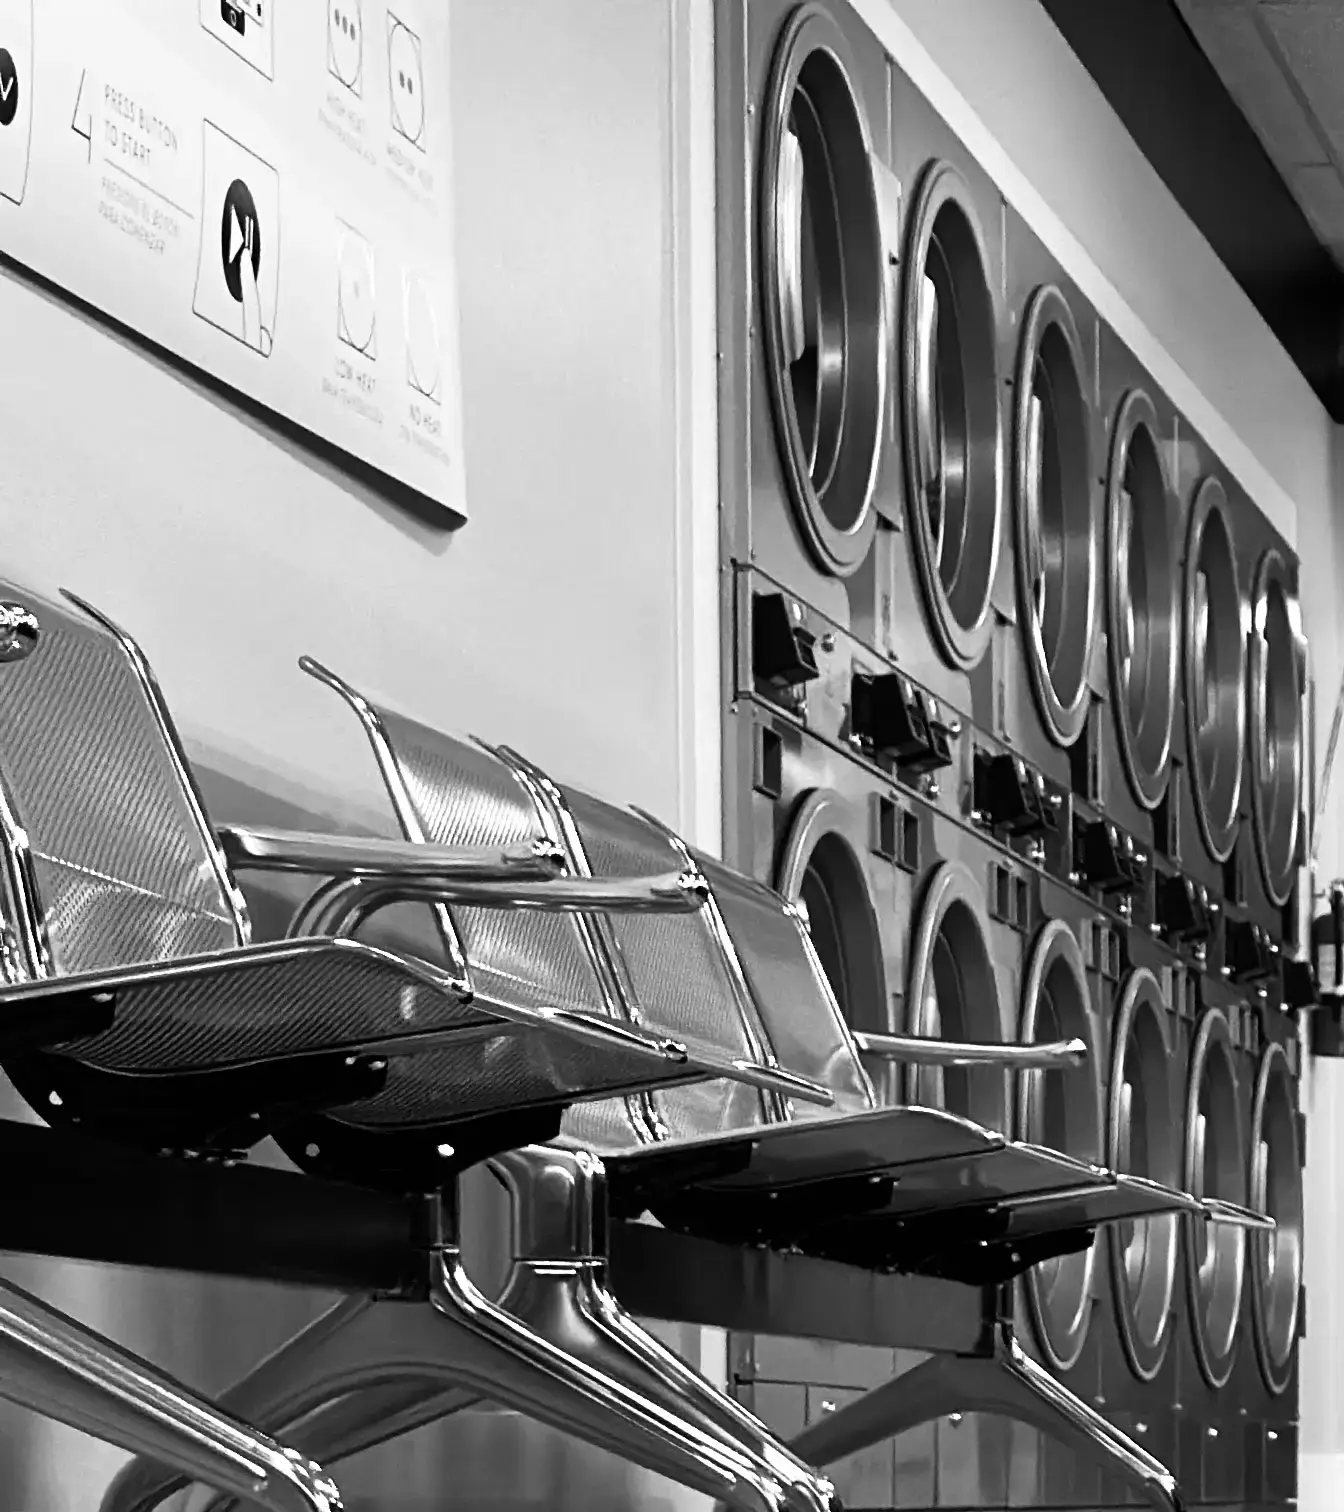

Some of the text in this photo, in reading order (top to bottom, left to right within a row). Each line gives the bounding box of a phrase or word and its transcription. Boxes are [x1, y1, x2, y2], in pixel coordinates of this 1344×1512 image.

[71, 68, 92, 164] 4
[104, 83, 178, 150] PRESS BUTTON
[104, 119, 151, 165] TO START
